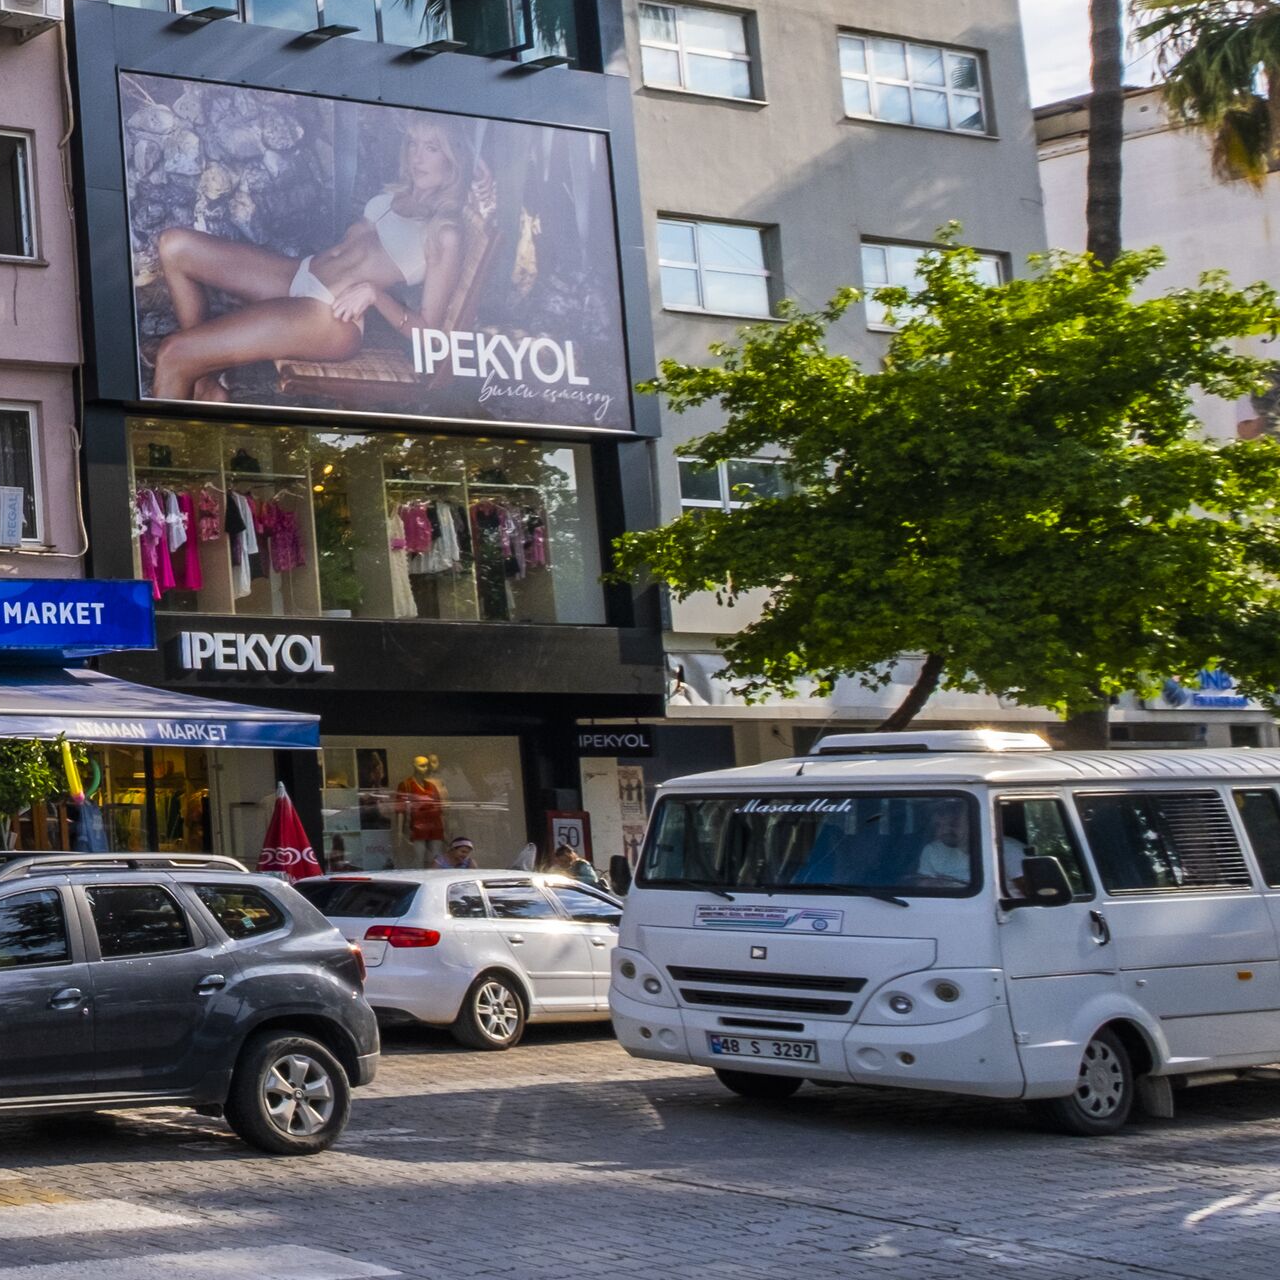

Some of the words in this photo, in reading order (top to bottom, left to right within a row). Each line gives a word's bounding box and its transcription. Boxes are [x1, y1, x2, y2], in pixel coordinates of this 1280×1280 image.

[411, 328, 590, 385] IPEKYOL
[7, 495, 18, 537] REGAL
[4, 601, 105, 626] MARKET
[180, 631, 335, 673] IPEKYOL
[75, 722, 147, 739] ATAMAN
[156, 723, 228, 741] MARKET
[579, 734, 649, 748] IPEKYOL
[721, 1038, 740, 1053] 48
[751, 1041, 761, 1054] S
[772, 1042, 813, 1059] 3297
